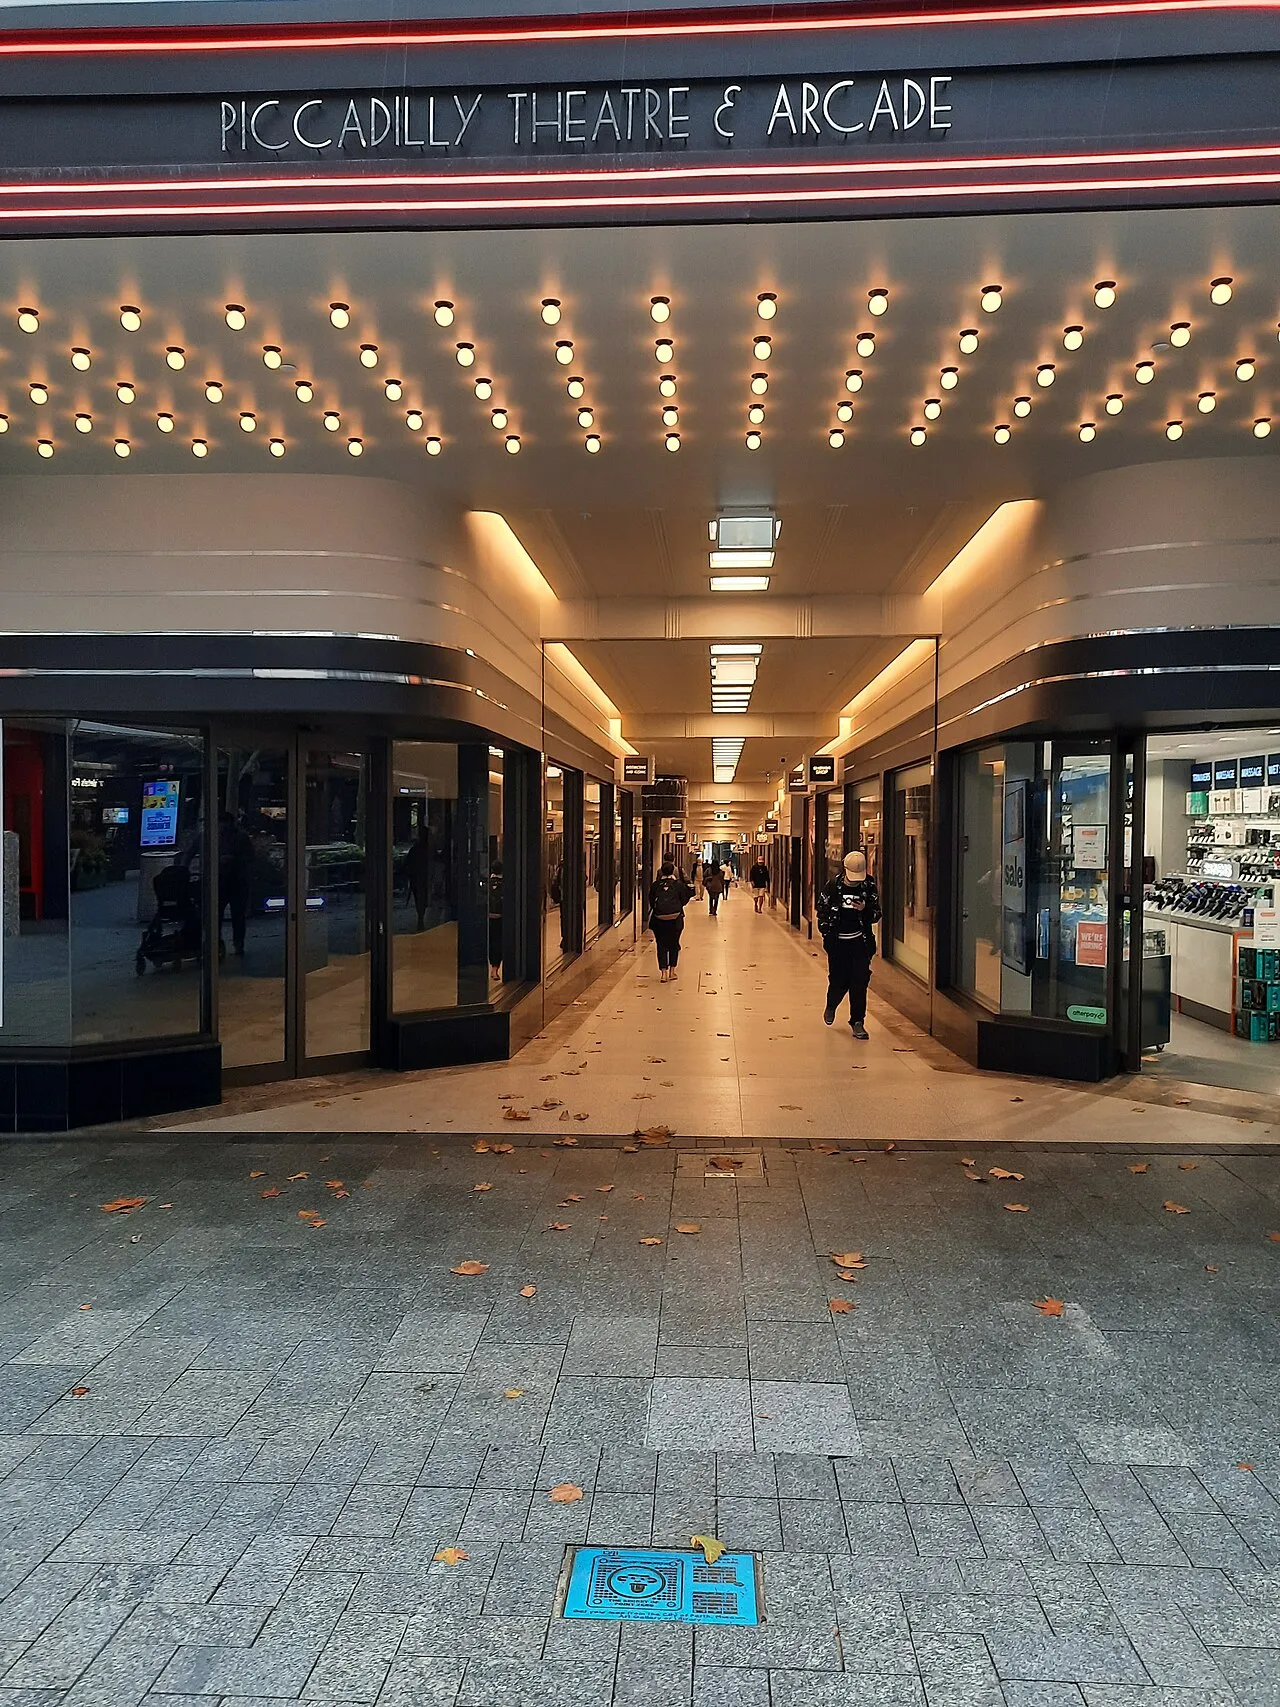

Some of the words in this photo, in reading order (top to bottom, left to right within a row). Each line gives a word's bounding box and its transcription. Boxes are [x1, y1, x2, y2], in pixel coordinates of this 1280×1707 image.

[221, 93, 482, 151] PICCADILLY
[508, 86, 690, 143] THEATRE
[714, 85, 741, 138] &
[767, 76, 953, 135] ARCADE
[1005, 856, 1023, 888] sale
[1081, 932, 1104, 942] WE'RE
